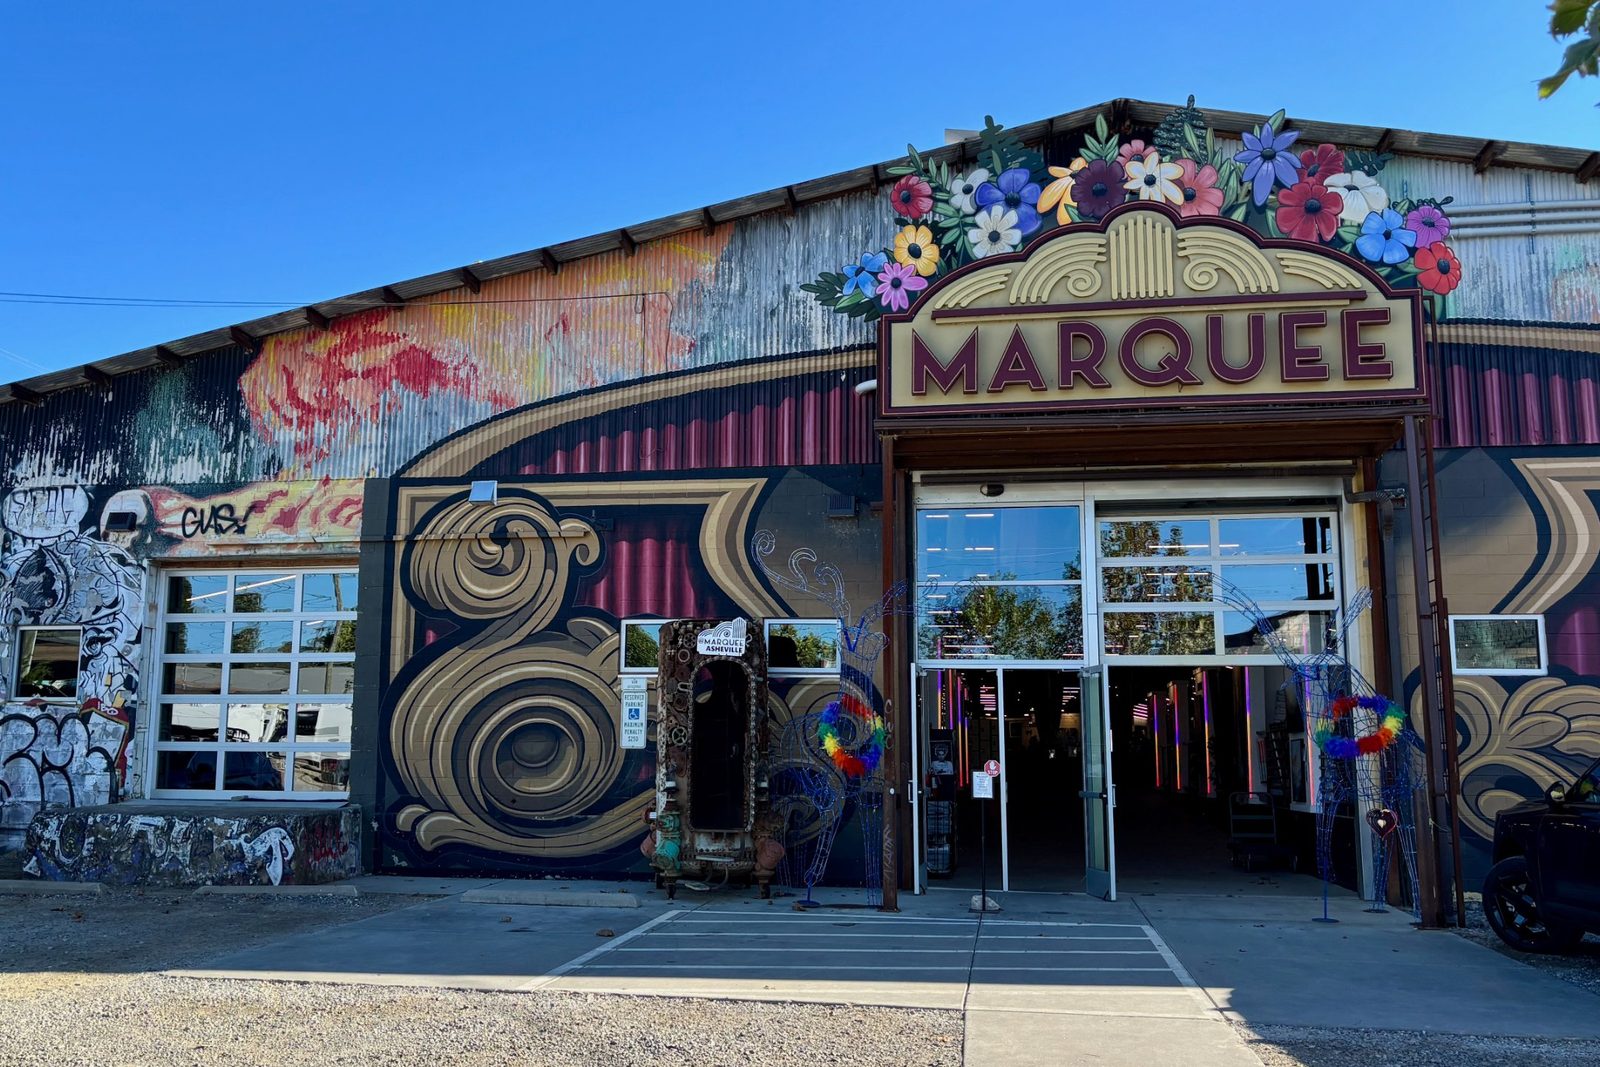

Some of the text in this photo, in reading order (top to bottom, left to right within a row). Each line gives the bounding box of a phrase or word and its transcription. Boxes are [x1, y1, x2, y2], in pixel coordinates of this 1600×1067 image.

[911, 307, 1394, 397] MARQUEE
[704, 638, 744, 647] MARQUEE
[705, 645, 743, 653] ASHEVILLE
